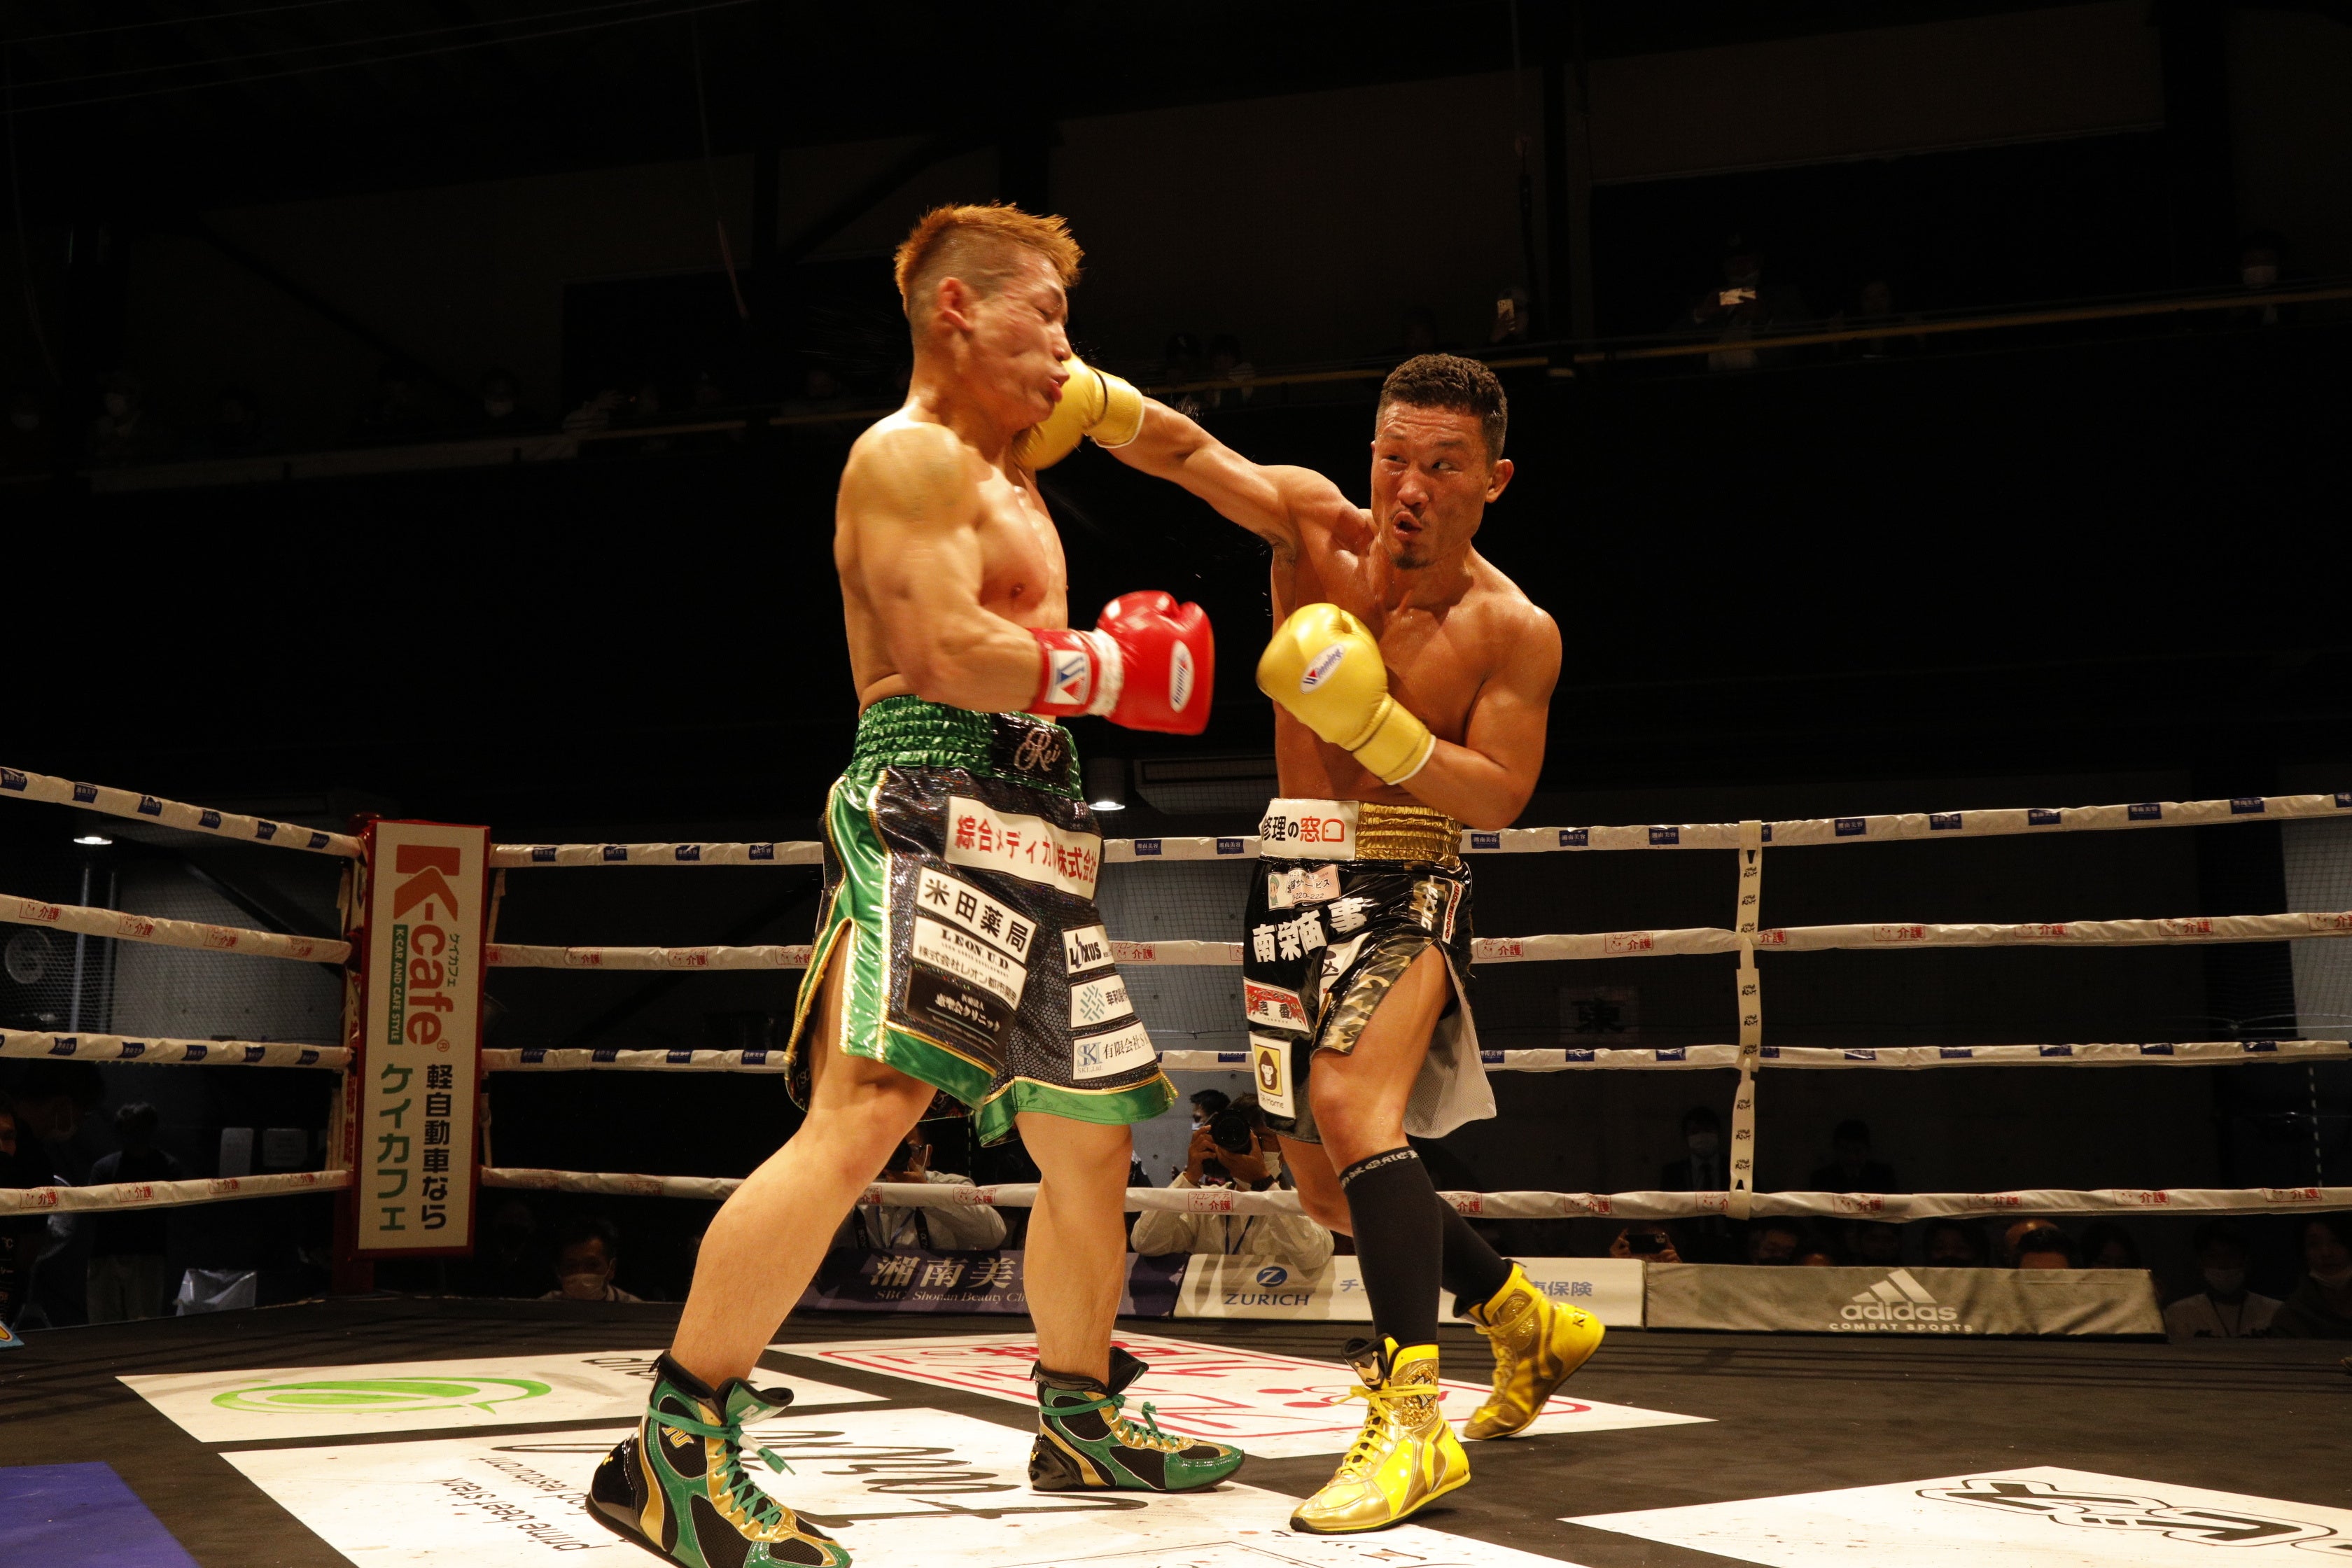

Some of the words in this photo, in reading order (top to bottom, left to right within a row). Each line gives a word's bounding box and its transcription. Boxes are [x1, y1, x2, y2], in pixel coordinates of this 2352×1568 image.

[39, 906, 60, 920] 介護
[925, 878, 1028, 953] 米田薬局
[134, 922, 153, 937] 介護
[1898, 927, 1924, 939] 介護
[2038, 925, 2066, 936] 介護
[2183, 921, 2211, 933] 介護
[394, 929, 405, 959] K-CAR
[1760, 931, 1785, 944] 介護
[1498, 946, 1522, 956] 介護
[1628, 939, 1652, 951] 介護
[447, 933, 461, 988] ケイカフェ
[582, 953, 600, 965] 介護
[686, 954, 706, 965] 介護
[1132, 948, 1154, 960] 介護
[393, 961, 403, 986] AND
[393, 987, 402, 1011] CAFE
[391, 1013, 401, 1041] STYLE
[377, 1063, 413, 1231] ケイカフェ
[421, 1064, 453, 1230] 軽自動車なら
[38, 1191, 57, 1205] 介護
[134, 1186, 153, 1198] 介護
[2141, 1191, 2168, 1203] 介護
[2292, 1189, 2319, 1199] 介護
[972, 1194, 994, 1205] 介護
[1209, 1199, 1232, 1212] 介護
[1457, 1198, 1480, 1212] 介護
[1586, 1200, 1610, 1213] 介護
[1857, 1199, 1882, 1211] 介護
[870, 1255, 1027, 1288] 湘南美
[875, 1290, 906, 1300] SBC
[913, 1290, 958, 1301] Shonan
[962, 1292, 1003, 1305] Beauty
[1224, 1294, 1309, 1307] ZURICH
[1840, 1301, 1958, 1322] adidas
[1829, 1322, 1901, 1331] COMBAT
[1906, 1323, 1973, 1333] SPORTS
[469, 1457, 575, 1492] restaurant
[416, 1477, 497, 1499] steak
[451, 1501, 538, 1524] beef
[517, 1522, 612, 1551] prime
